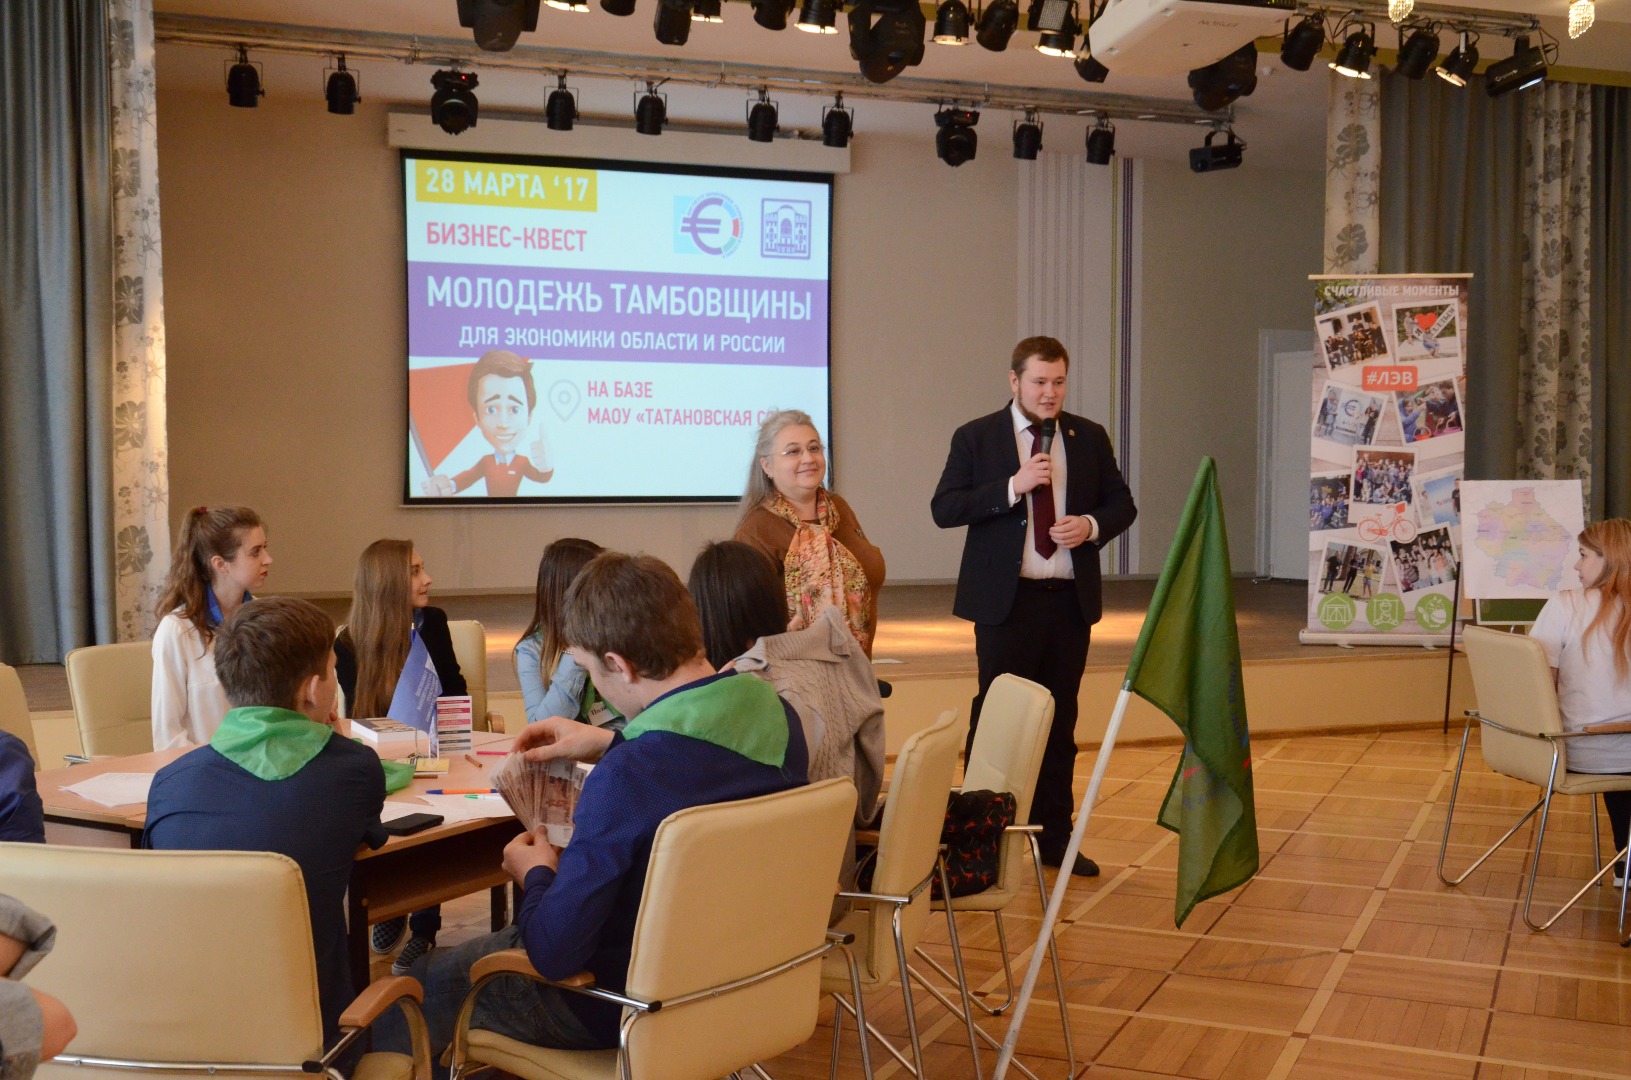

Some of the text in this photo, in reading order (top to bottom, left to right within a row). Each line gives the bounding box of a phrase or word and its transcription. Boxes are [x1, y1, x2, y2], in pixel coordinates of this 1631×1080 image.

[426, 167, 455, 193] 28
[463, 169, 545, 199] МАРТА
[426, 221, 588, 251] БИЗНЕС-КВЕСТ
[427, 275, 812, 324] МОЛОДЕЖЬ ТАМБОВЩИНЫ
[1324, 285, 1459, 296] СЧАСТЛИВЫЕ МОМЕНТЫ
[458, 325, 785, 353] ДЛЯ ЭКОНОМИКИ ОБЛАСТИ И РОССИИ
[587, 380, 653, 399] НА БАЗЕ
[1366, 371, 1413, 385] #ЛЭВ
[587, 408, 631, 424] МАОУ
[636, 408, 752, 426] «ТАТАНОВСКАЯ
